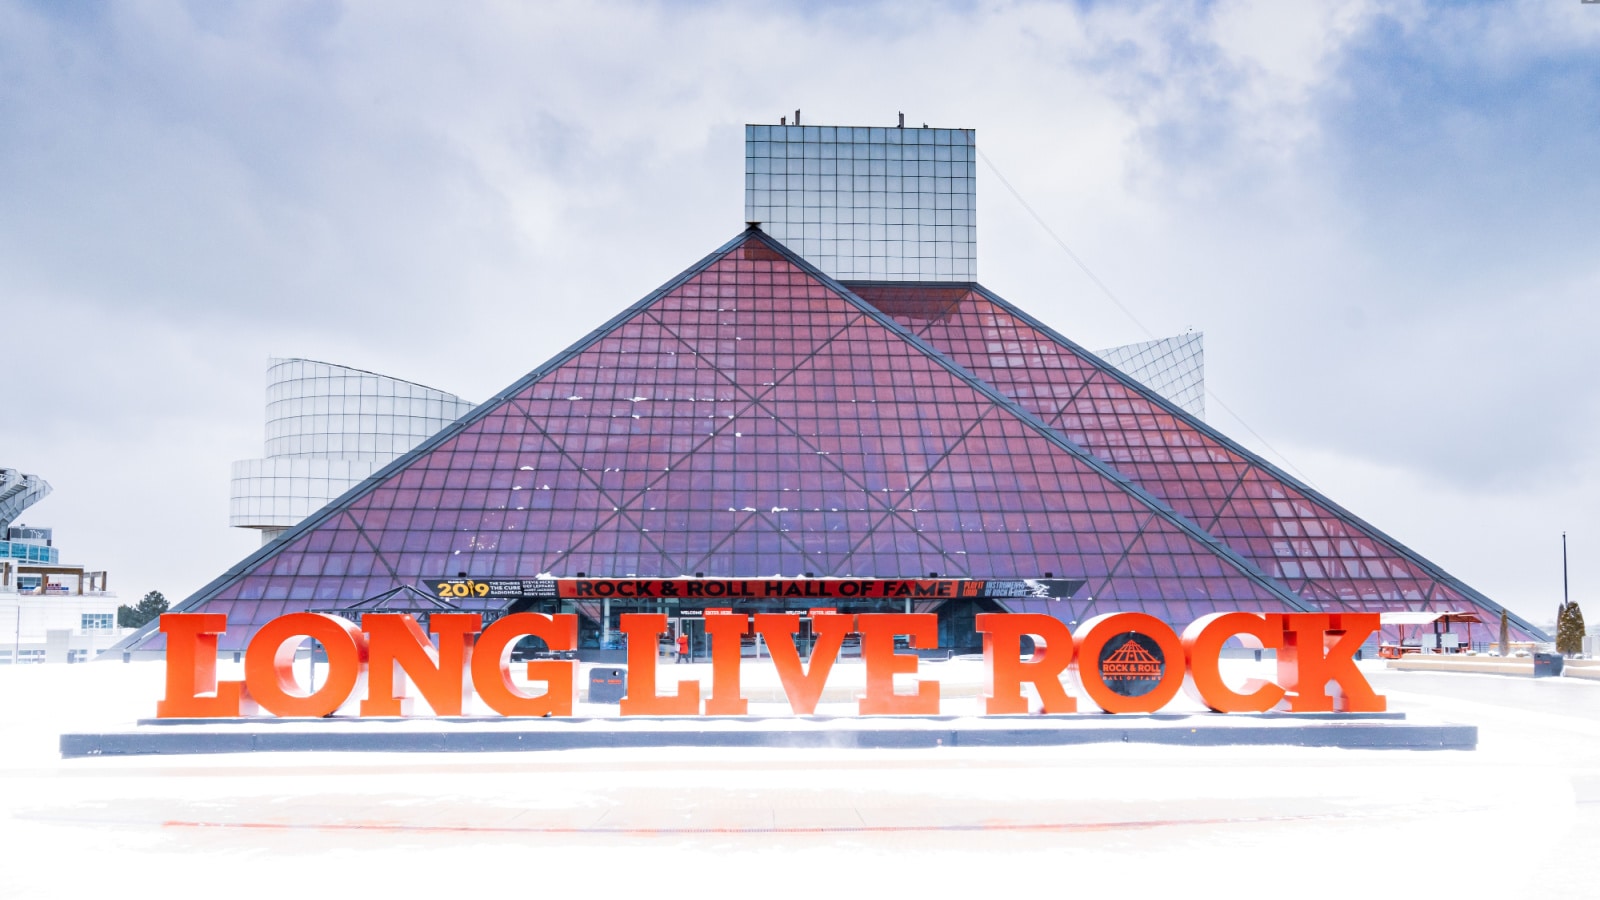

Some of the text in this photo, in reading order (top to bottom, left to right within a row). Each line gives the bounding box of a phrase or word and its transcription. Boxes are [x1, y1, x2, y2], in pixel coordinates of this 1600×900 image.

[576, 581, 953, 597] ROCK & ROLL HALL OF FAME
[157, 612, 1387, 718] LONG LIVE ROCK
[1103, 664, 1161, 672] ROCK & ROLL
